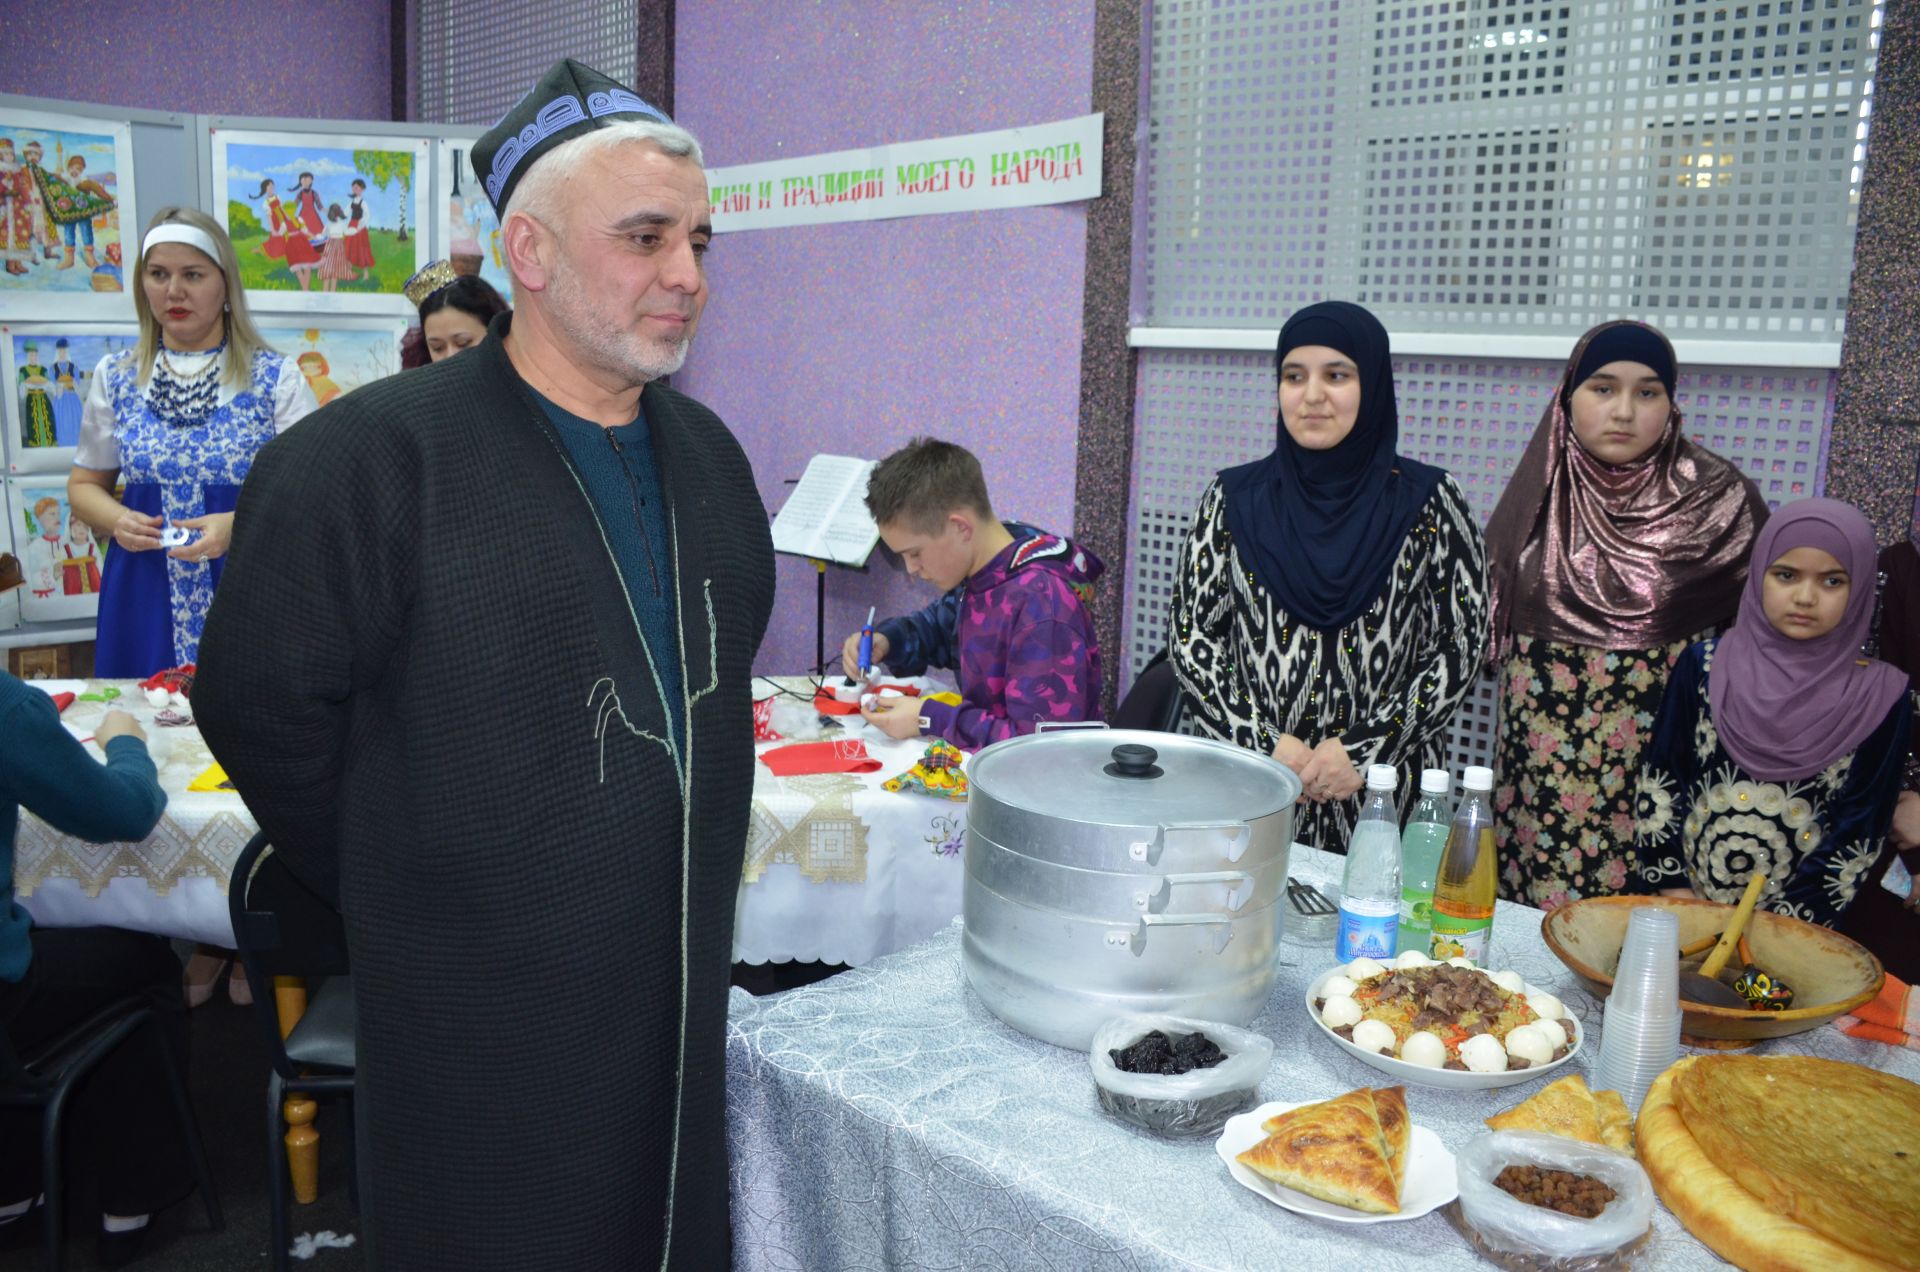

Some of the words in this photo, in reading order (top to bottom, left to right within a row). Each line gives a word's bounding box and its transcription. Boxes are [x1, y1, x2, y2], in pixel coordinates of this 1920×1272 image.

[758, 180, 773, 210] И
[781, 167, 885, 208] ТРАДИЦИИ
[896, 156, 976, 196] МОЕГО
[990, 141, 1083, 187] НАРОДА
